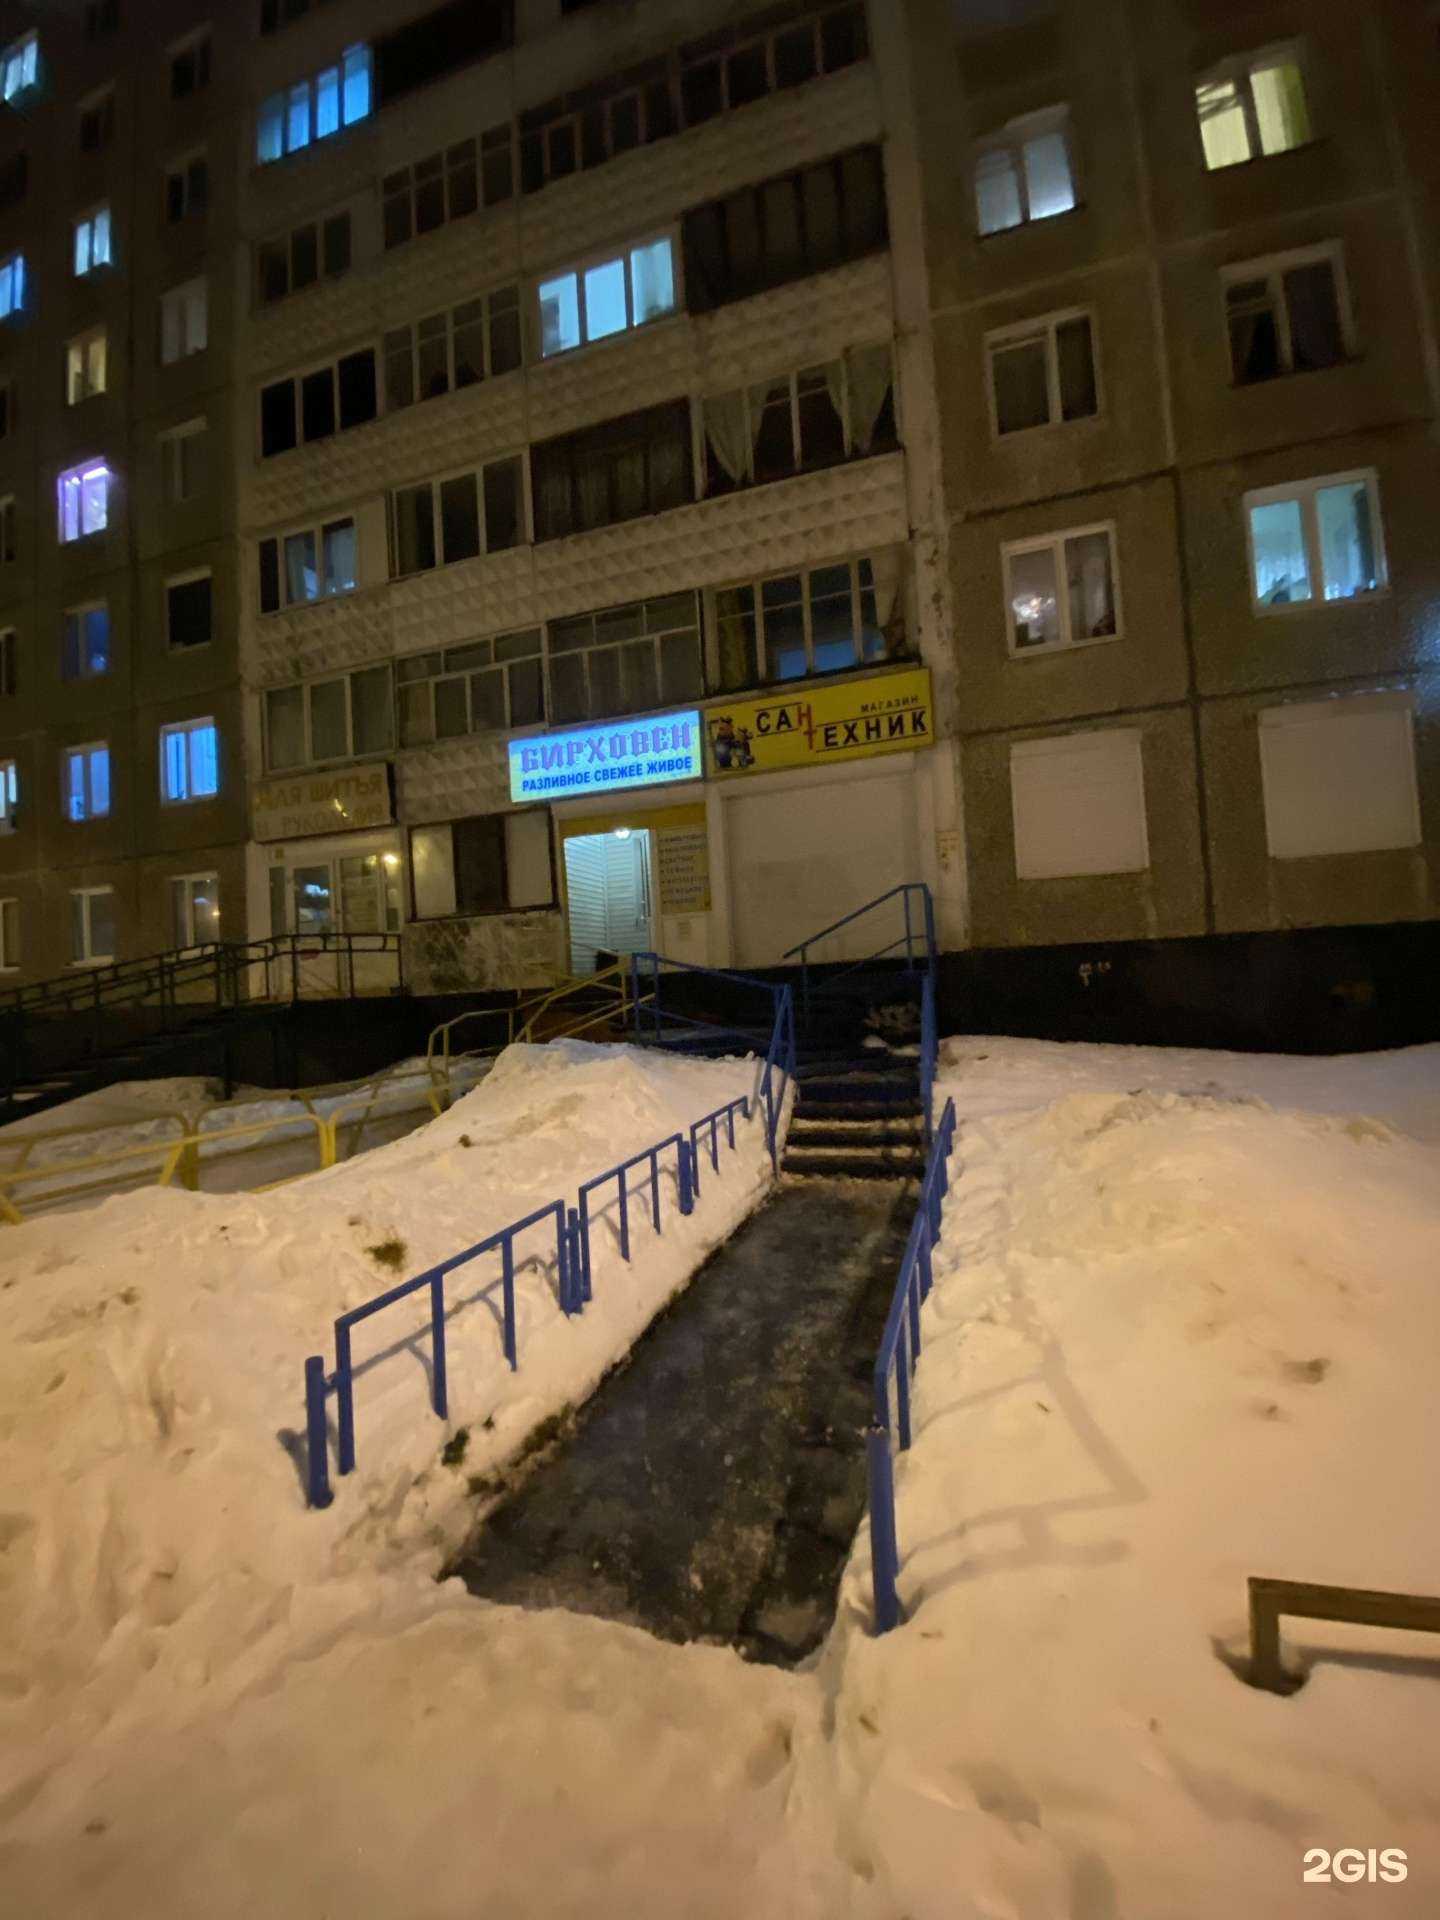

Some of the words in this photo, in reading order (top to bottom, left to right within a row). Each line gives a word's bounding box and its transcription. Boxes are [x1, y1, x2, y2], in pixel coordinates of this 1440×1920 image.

[861, 695, 919, 713] МАГАЗИН
[521, 721, 692, 773] БИРХОВЕН
[310, 773, 382, 802] ШИТЬЯ
[522, 771, 591, 792] РАЗЛИВНОЕ
[594, 763, 643, 782] СВЕЖЕЕ
[647, 756, 692, 775] ЖИВОЕ
